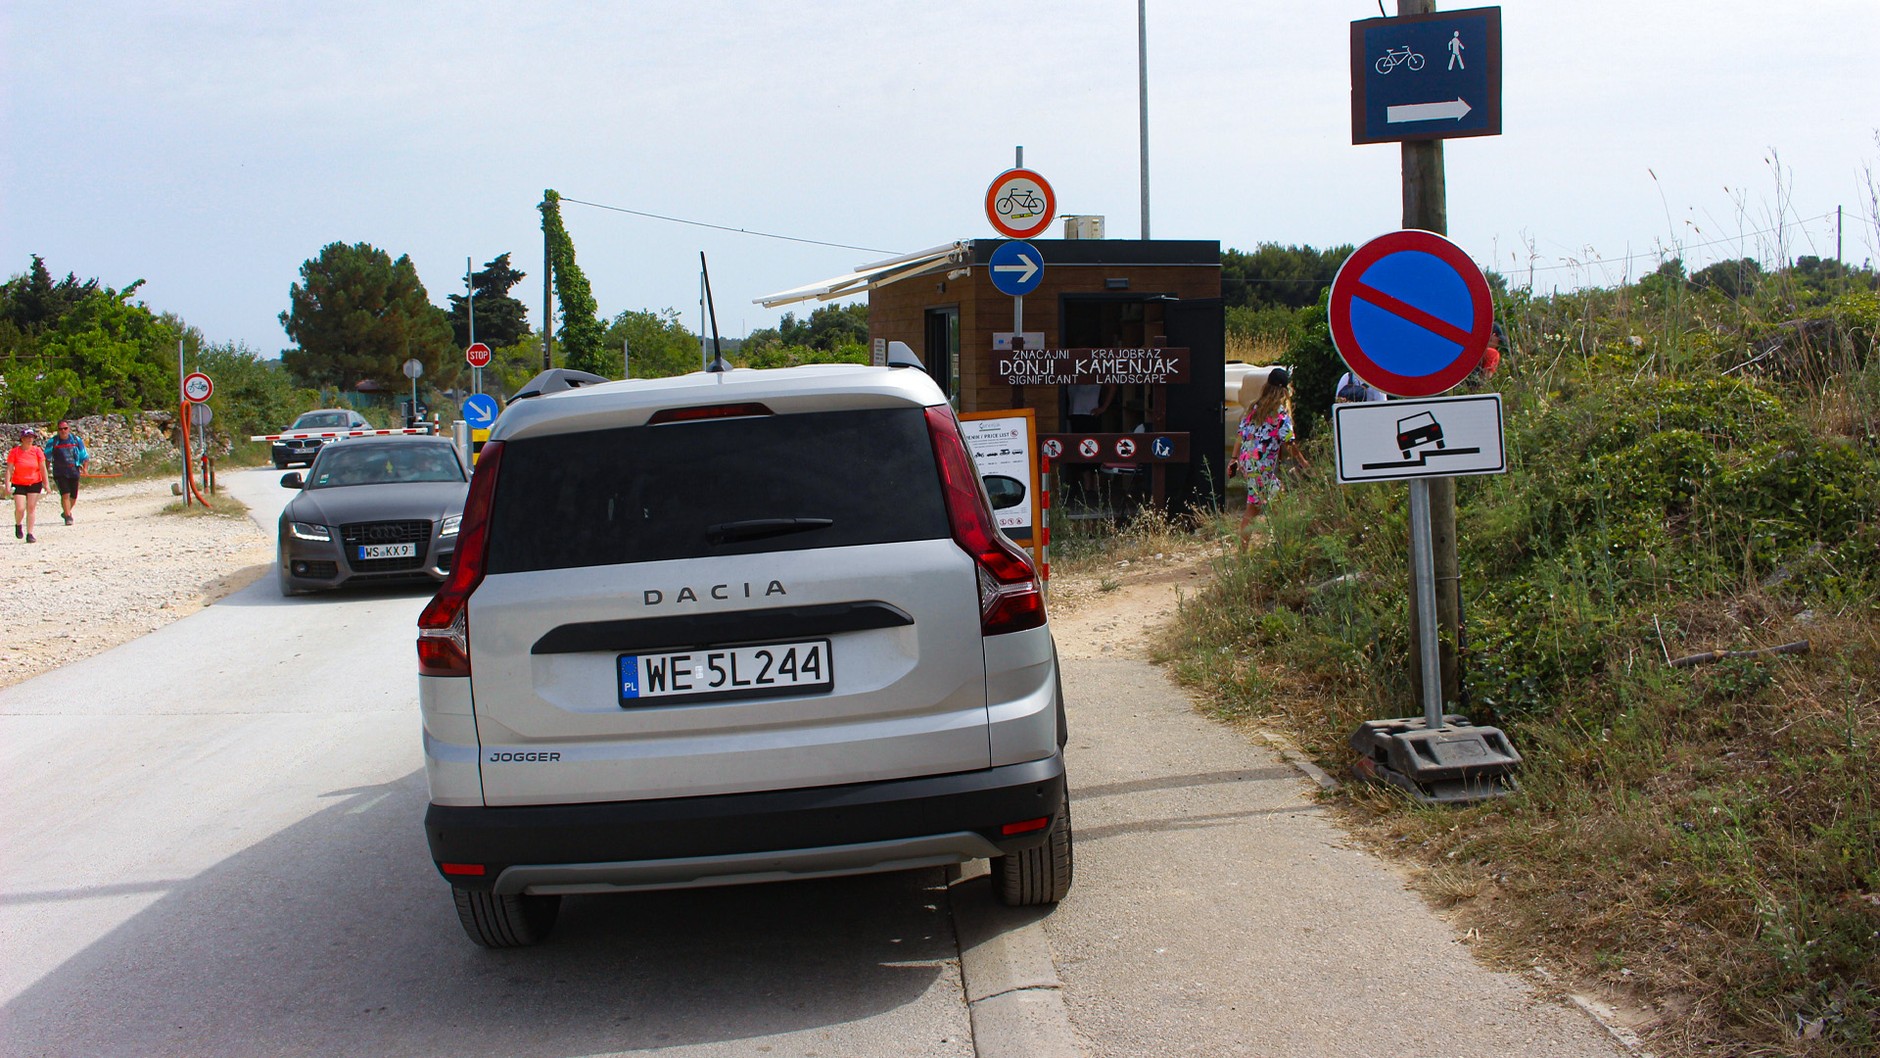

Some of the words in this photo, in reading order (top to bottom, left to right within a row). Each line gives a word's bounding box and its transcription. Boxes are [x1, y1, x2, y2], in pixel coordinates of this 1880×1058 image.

[470, 351, 488, 360] STOP
[1091, 348, 1162, 359] KRAJOBRAZ
[1000, 359, 1054, 376] DONJI
[1075, 358, 1179, 375] KAMENJAK
[1008, 374, 1079, 385] SIGNIFICANT
[1096, 373, 1167, 384] LANDSCAPE
[365, 546, 380, 557] WS
[386, 546, 400, 556] KX
[643, 580, 787, 606] DACIA
[624, 682, 637, 692] PL
[646, 655, 693, 692] WE
[707, 645, 821, 688] 5L244
[490, 752, 561, 762] JOGGER
